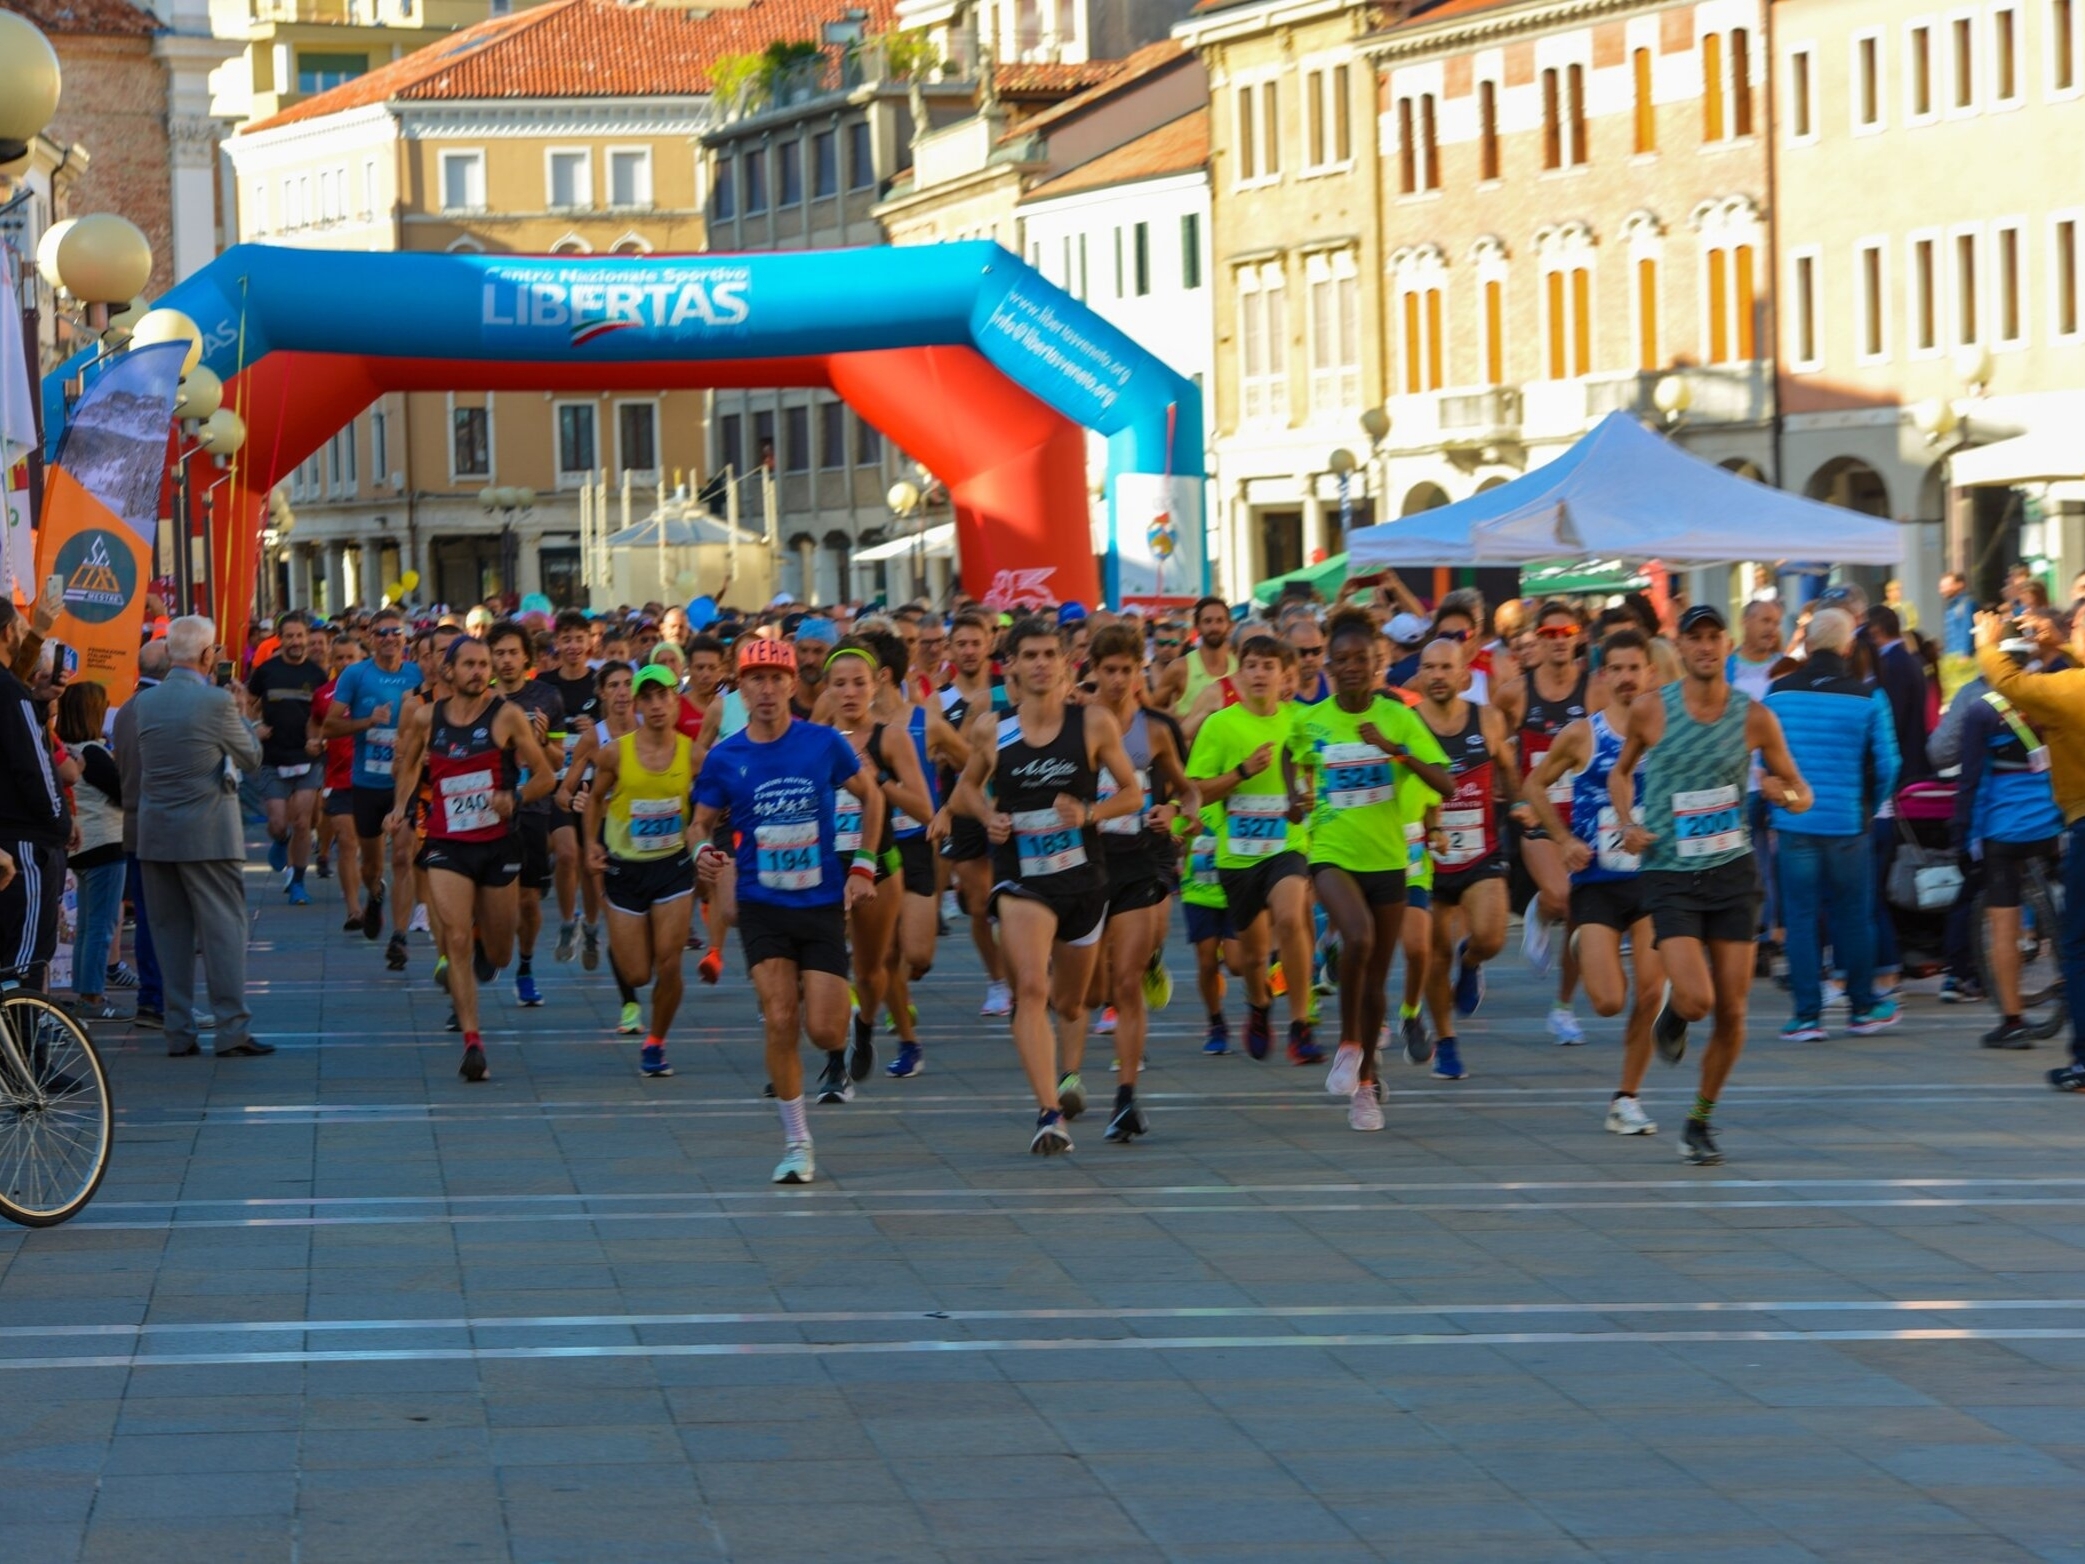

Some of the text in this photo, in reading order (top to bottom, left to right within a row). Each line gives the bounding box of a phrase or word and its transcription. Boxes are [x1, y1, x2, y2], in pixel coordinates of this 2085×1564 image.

[484, 265, 748, 286] Centro Nazionale Sportivo
[482, 282, 751, 327] LIBERTAS
[1337, 765, 1383, 790] 524
[451, 792, 490, 816] 240
[638, 815, 677, 837] 237
[1236, 816, 1280, 839] 527
[1686, 810, 1734, 837] 200
[1027, 830, 1073, 857] 183
[768, 845, 812, 872] 194
